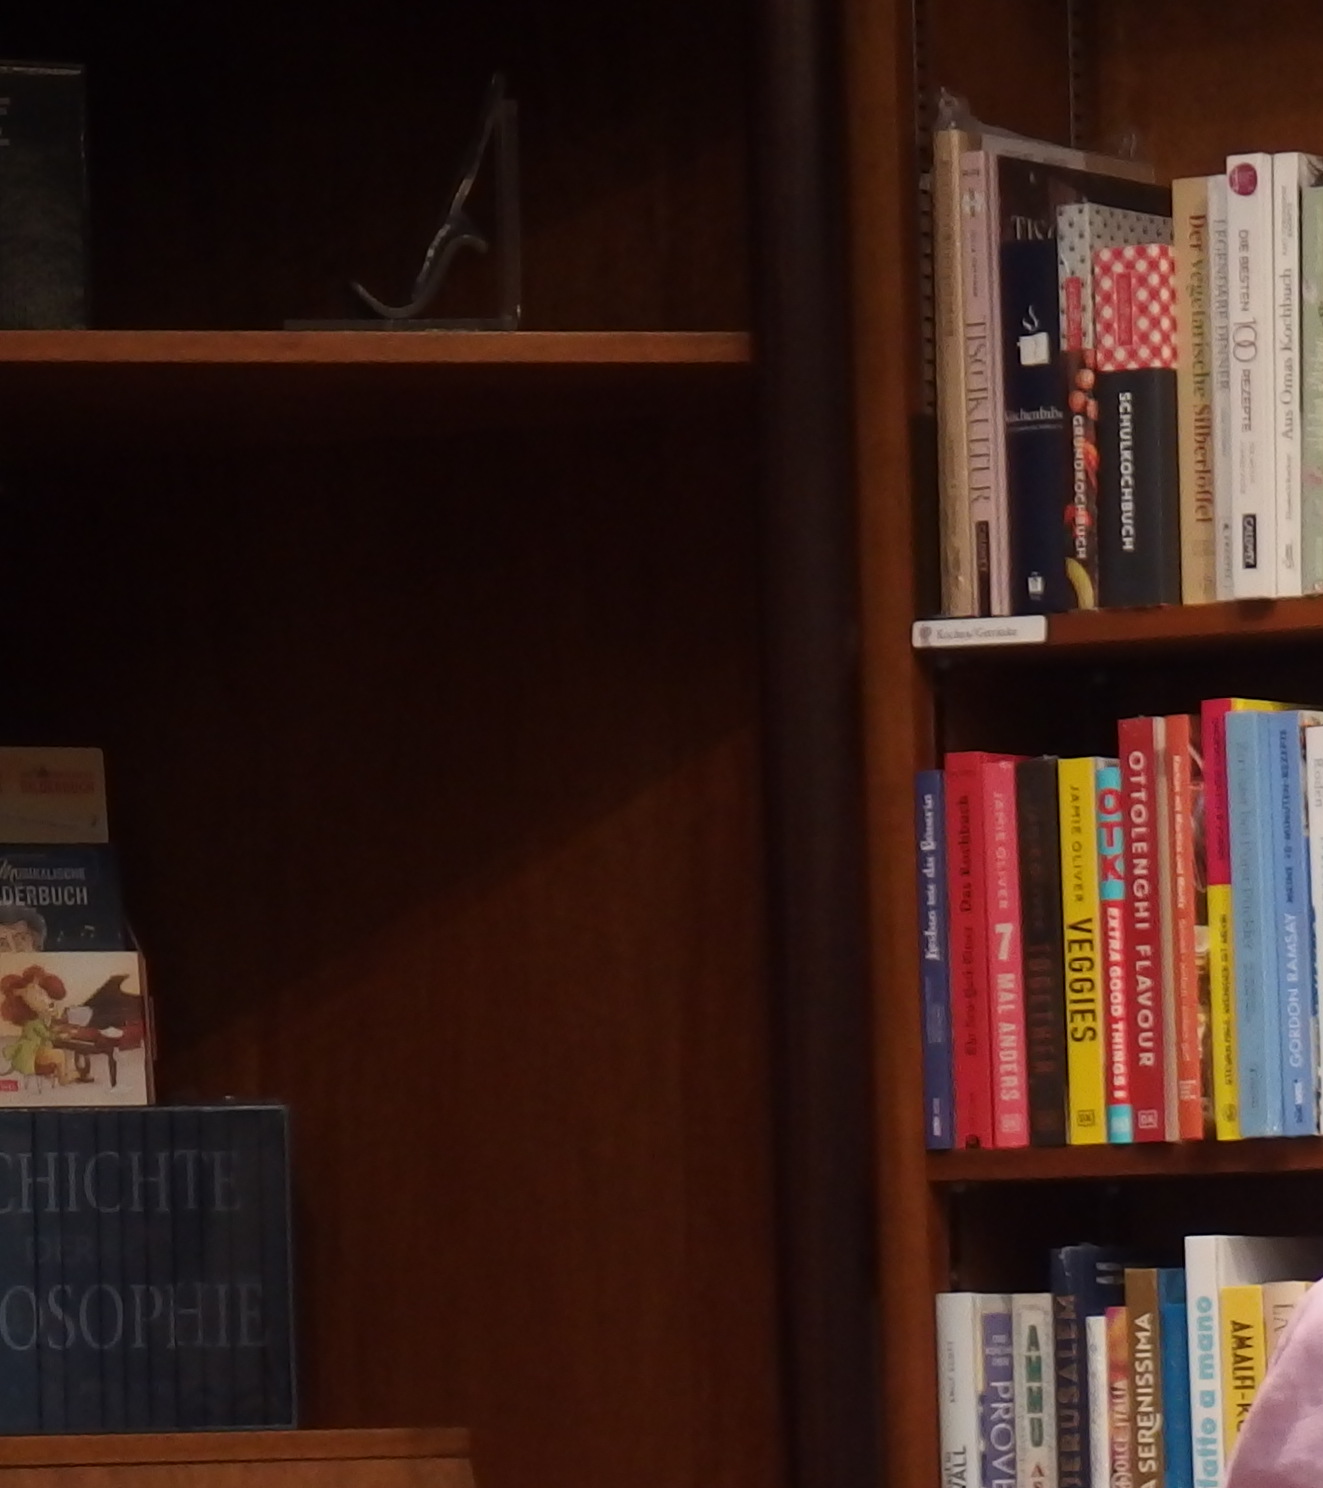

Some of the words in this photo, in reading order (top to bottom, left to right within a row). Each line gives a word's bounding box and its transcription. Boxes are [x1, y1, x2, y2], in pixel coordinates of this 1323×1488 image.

[1073, 415, 1087, 558] GRUNDKOCHBUCH
[1119, 392, 1134, 550] SCHULKOCHBUCH
[1070, 785, 1082, 835] JAMIE
[1072, 841, 1084, 902] OLIVER
[1129, 751, 1149, 930] OTTOLENGHI
[1067, 918, 1096, 1043] VEGGIES
[1135, 945, 1154, 1067] FLAVOUR
[1134, 1312, 1162, 1479] SERENISSIMA
